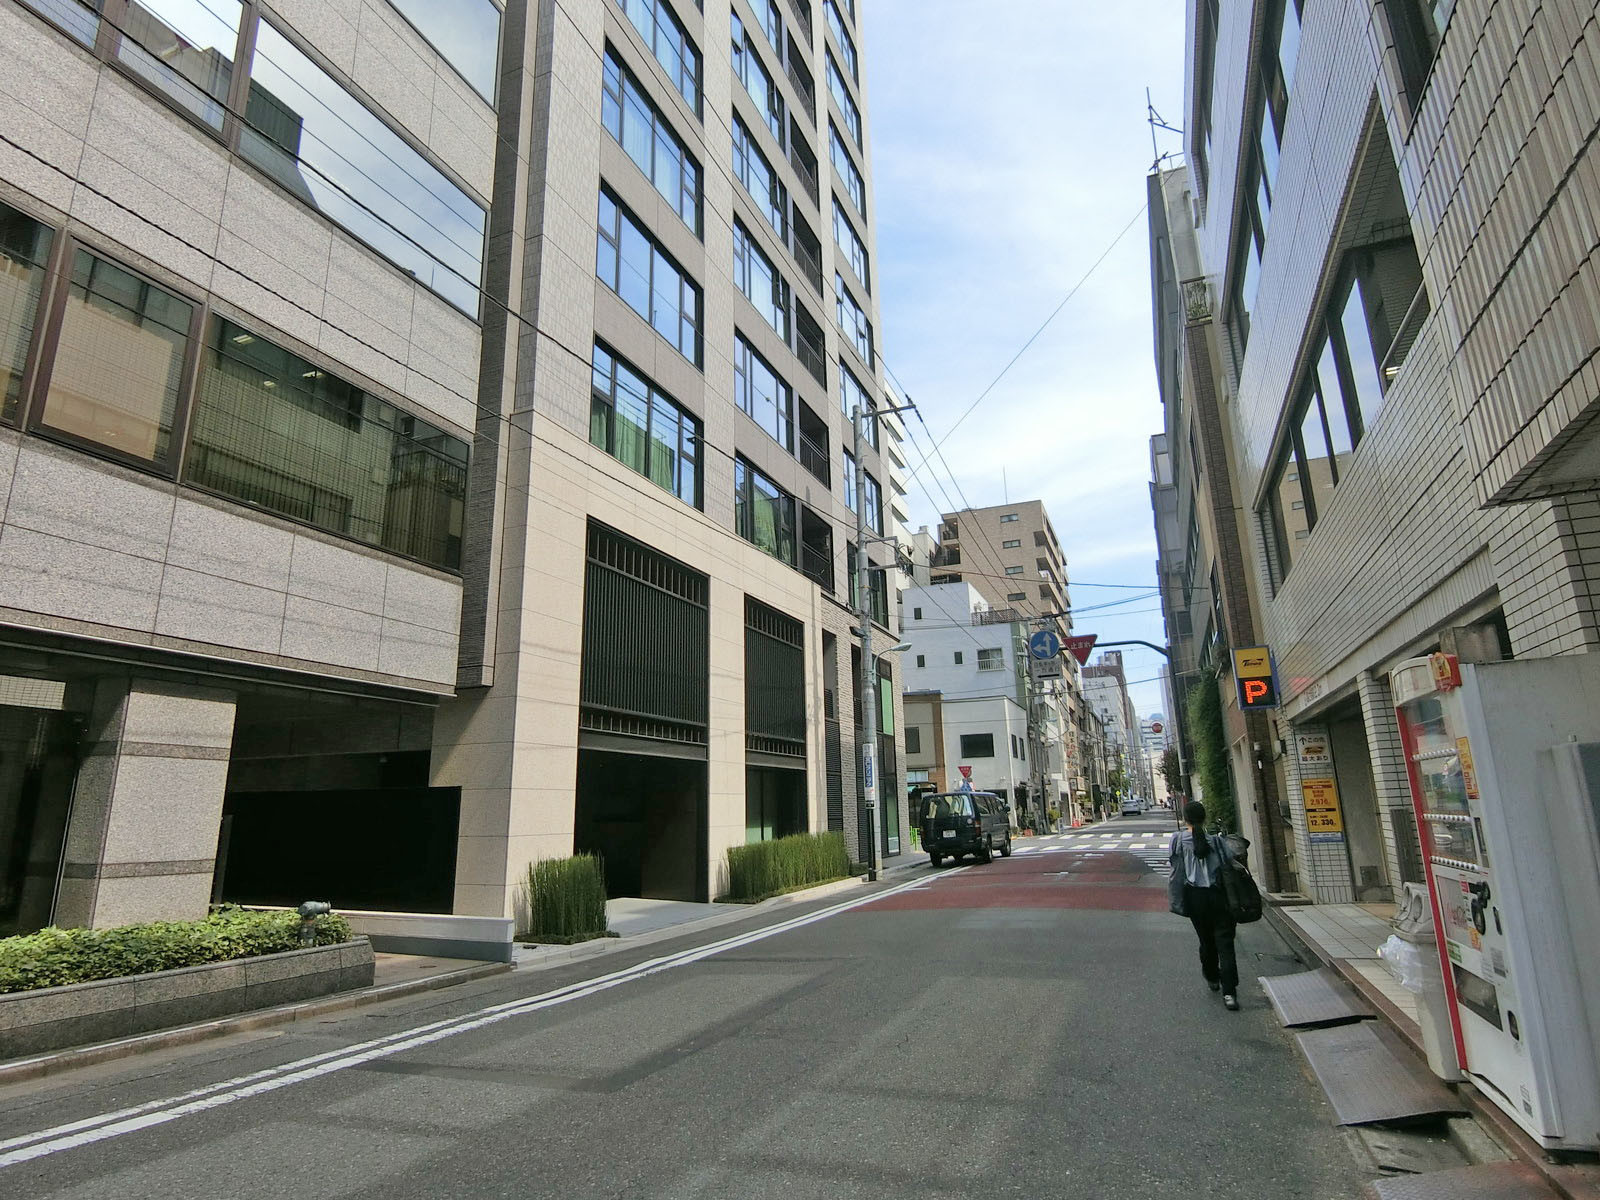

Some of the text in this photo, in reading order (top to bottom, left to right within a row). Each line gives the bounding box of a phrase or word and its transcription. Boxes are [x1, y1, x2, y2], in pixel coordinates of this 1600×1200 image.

[1070, 641, 1092, 650] 止まれ
[1244, 680, 1268, 704] P
